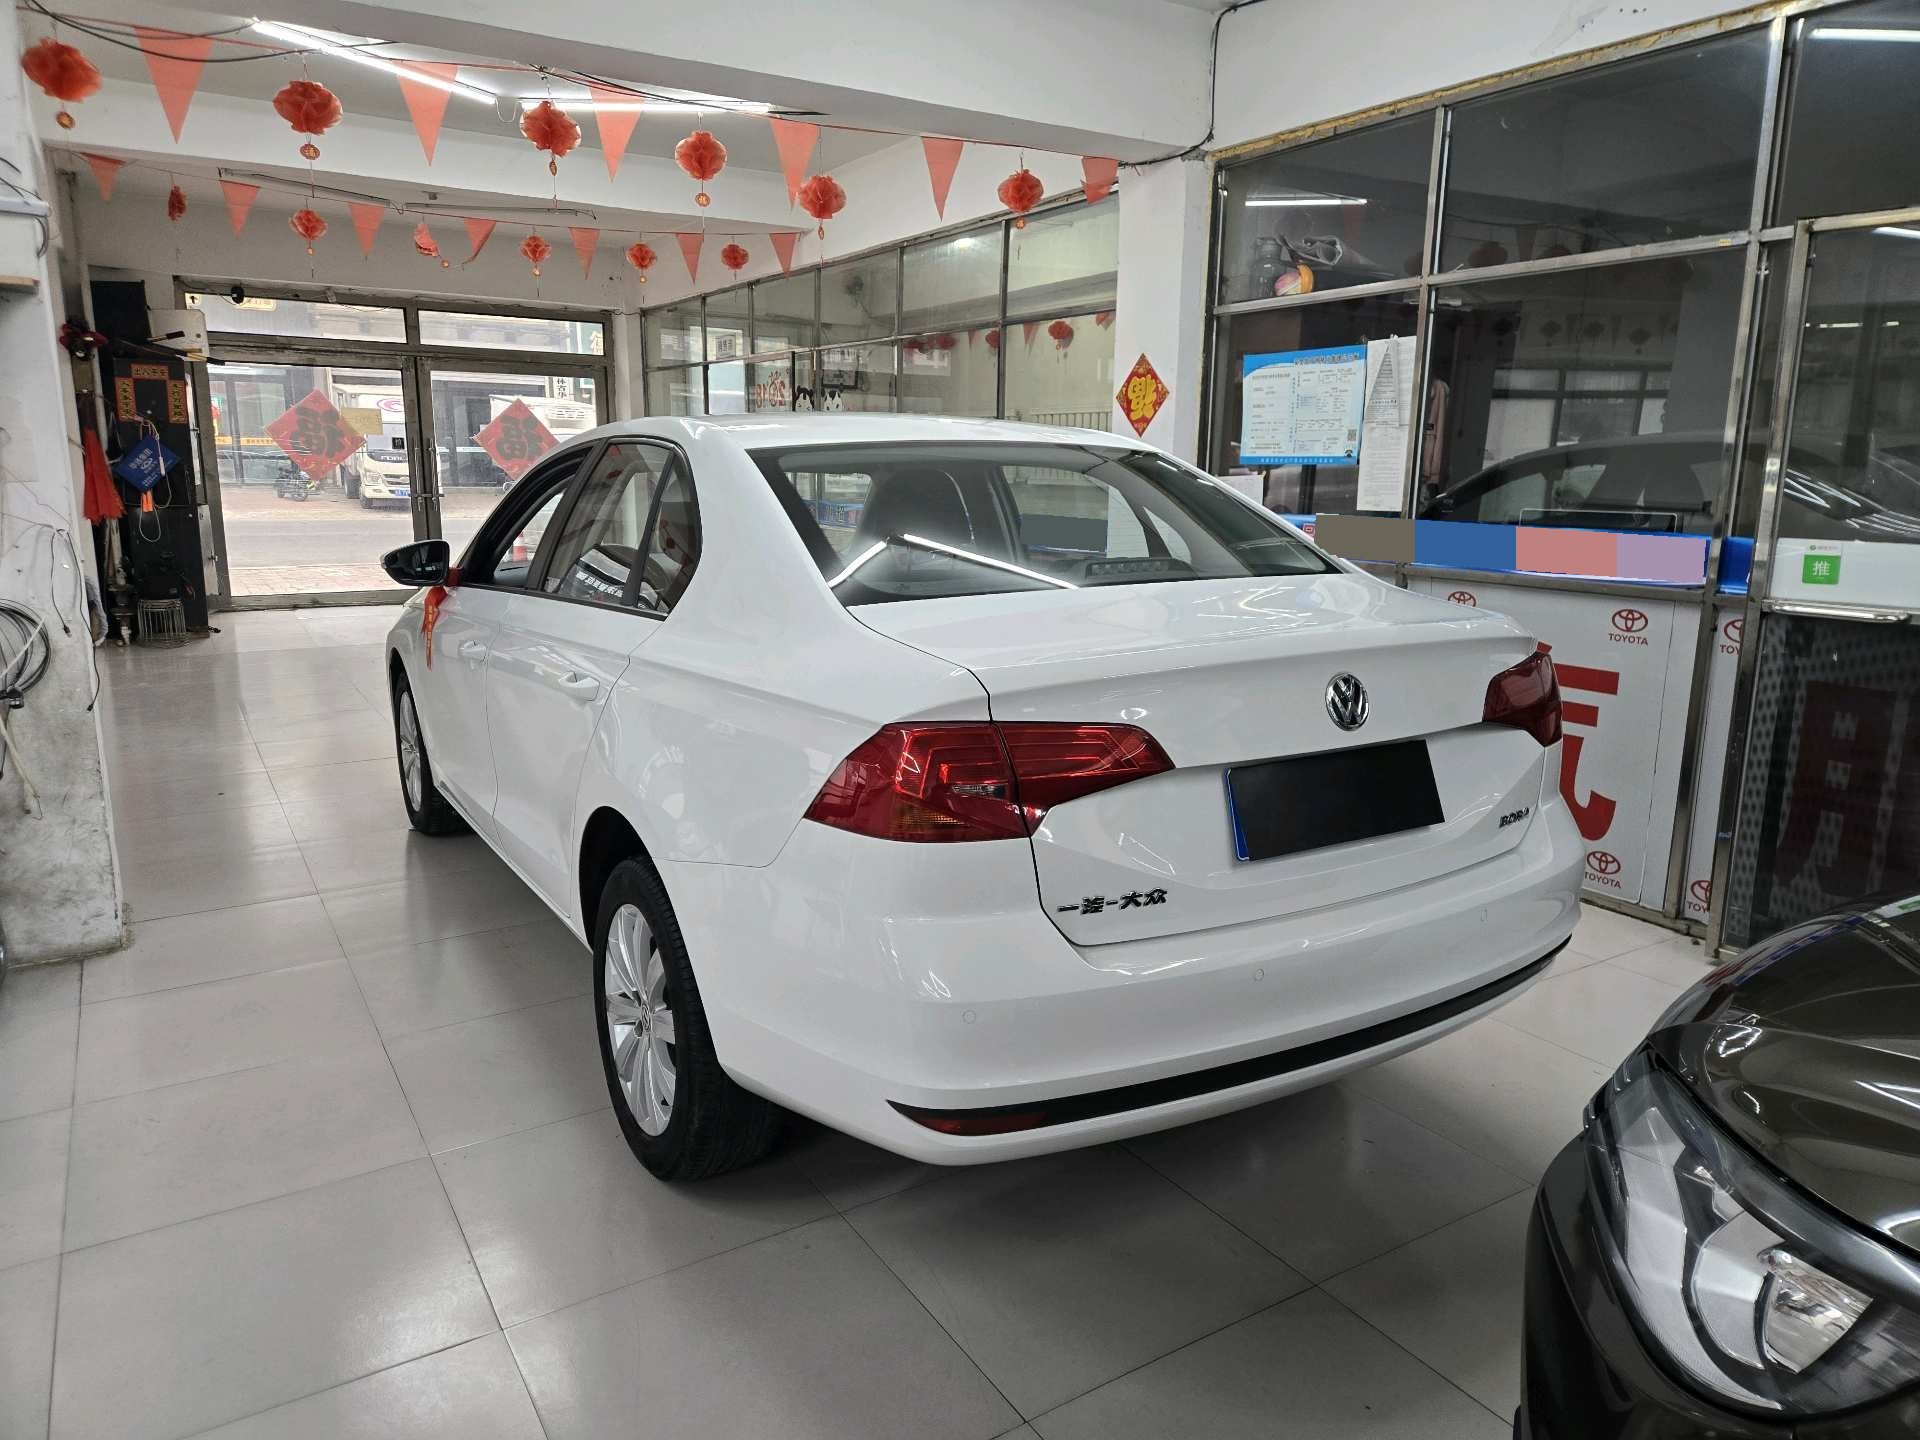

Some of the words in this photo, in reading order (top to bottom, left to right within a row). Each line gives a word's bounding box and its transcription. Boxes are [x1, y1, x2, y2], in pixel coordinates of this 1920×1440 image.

[1812, 560, 1832, 577] 推
[1608, 632, 1649, 646] TOYOTA
[1584, 871, 1622, 889] TOYOTA
